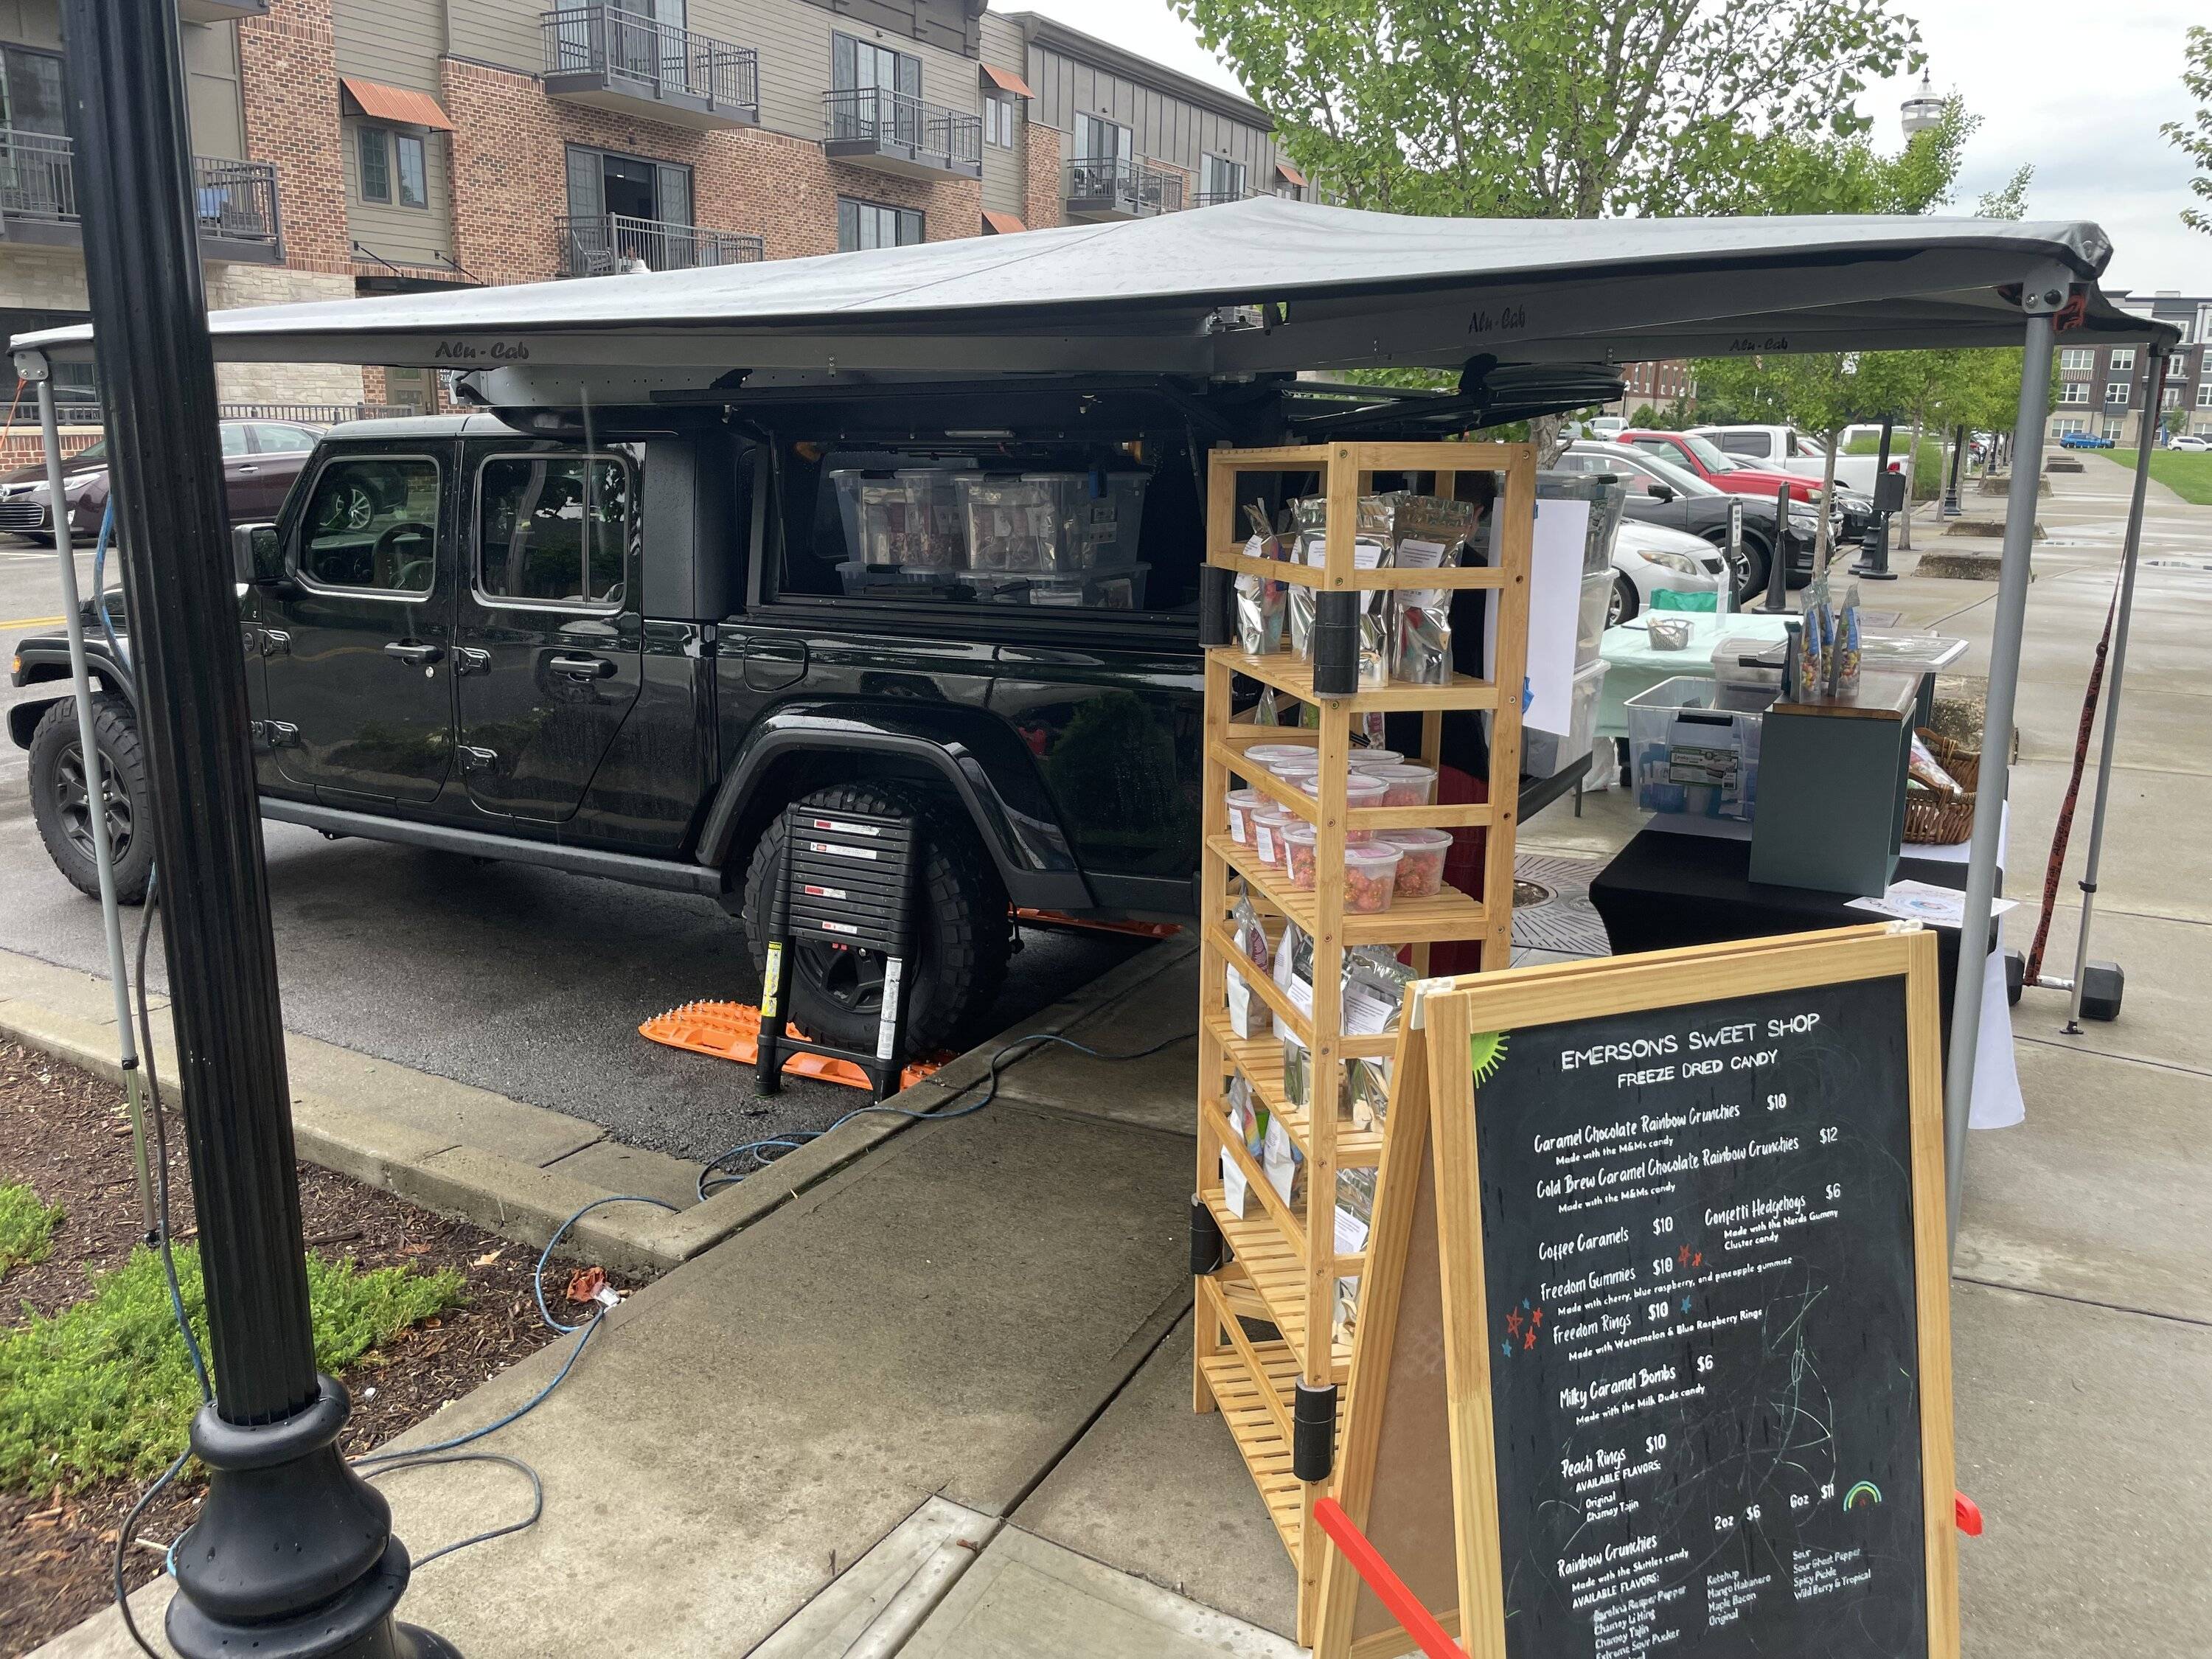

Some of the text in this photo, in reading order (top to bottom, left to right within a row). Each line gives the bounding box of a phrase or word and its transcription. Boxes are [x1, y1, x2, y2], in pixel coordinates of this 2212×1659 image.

[1562, 1013, 1820, 1071] EMERSON'S SWEET SHOP
[1618, 1065, 1675, 1088] FREEZE
[1731, 1049, 1778, 1069] CANDY
[1534, 1093, 1787, 1152] Caramel Chocolate Rainbow Crunchies $10
[1537, 1127, 1838, 1199] Cold Brew Caramel Chocolate Rainbow Crunchies $12
[1556, 1135, 1674, 1165] Made with the M&Ms candy
[1558, 1181, 1675, 1214] Made with the M&Ms candy
[1705, 1183, 1841, 1225] Confetti Hedgehogs $6
[1539, 1216, 1674, 1261] Coffee Caramels $10
[1724, 1210, 1839, 1239] Made with the Nerds Gummy
[1724, 1231, 1778, 1251] Cluster candy
[1540, 1256, 1673, 1301] Freedom Gummies $10
[1557, 1256, 1792, 1316] Made with cherry, blue raspberry, and pineapple gummies
[1553, 1301, 1669, 1345] Freedom Rings $10
[1568, 1309, 1762, 1361] Made with Watermelon & Blue Raspberry Rings
[1559, 1354, 1714, 1410] Milky Caramel Bombs $6
[1576, 1382, 1705, 1426] Made with the Milk Duds candy
[1561, 1433, 1666, 1479] Peach Rings $10
[1575, 1459, 1661, 1493] AVAILABLE FLAVORS:
[1585, 1490, 1616, 1509] Original
[1586, 1498, 1639, 1523] Chamoy Tajin
[1714, 1483, 1834, 1531] 2oz $6 6oz $11
[1557, 1534, 1658, 1578] Rainbow Crunchies
[1571, 1547, 1689, 1593] Made with the Skittles candy
[1792, 1548, 1812, 1561] Sour
[1792, 1548, 1861, 1574] Sour Ghost Pepper
[1572, 1572, 1660, 1610] AVAILABLE FLAVORS:
[1706, 1570, 1739, 1586] Ketchup
[1707, 1587, 1733, 1599] Mango
[1793, 1576, 1815, 1588] Spicy
[1793, 1568, 1871, 1601] Wild Berry & Tropical
[1708, 1607, 1739, 1627] Original
[1632, 1638, 1651, 1651] Sour
